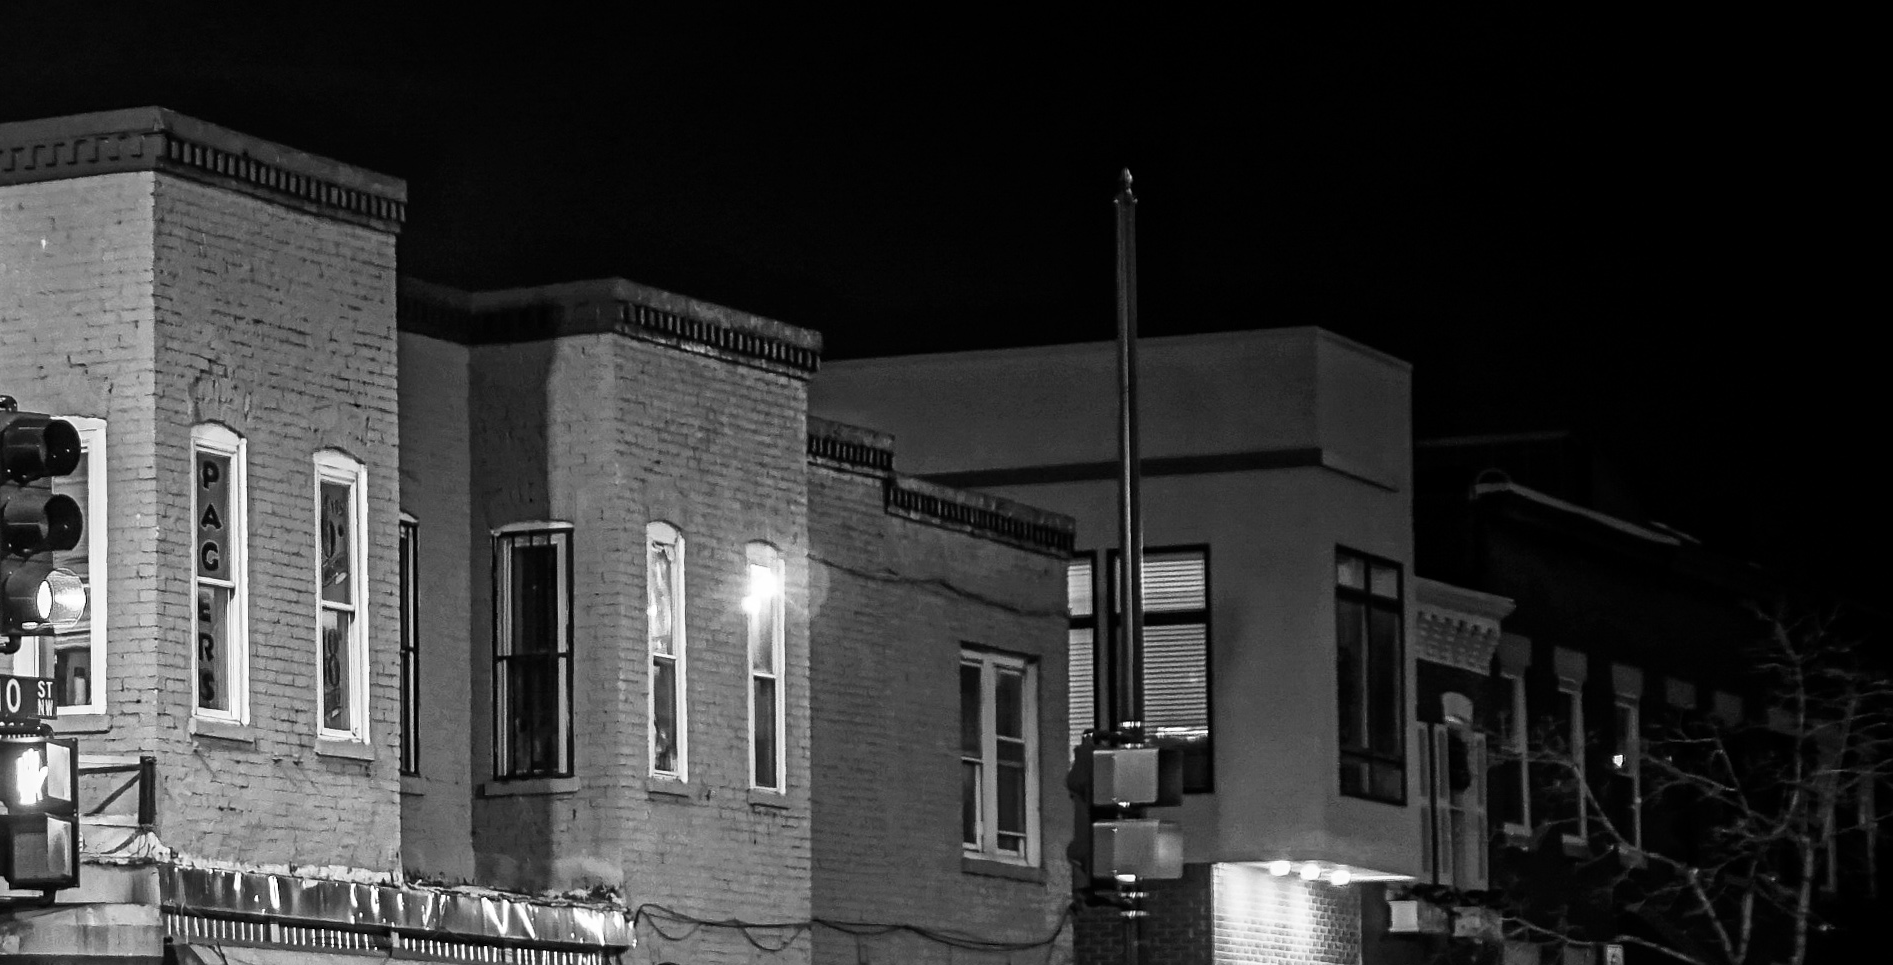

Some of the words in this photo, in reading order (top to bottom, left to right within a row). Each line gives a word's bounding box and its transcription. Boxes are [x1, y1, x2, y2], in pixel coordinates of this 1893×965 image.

[200, 460, 222, 702] PAGERS
[37, 680, 53, 699] ST
[37, 699, 54, 717] NW
